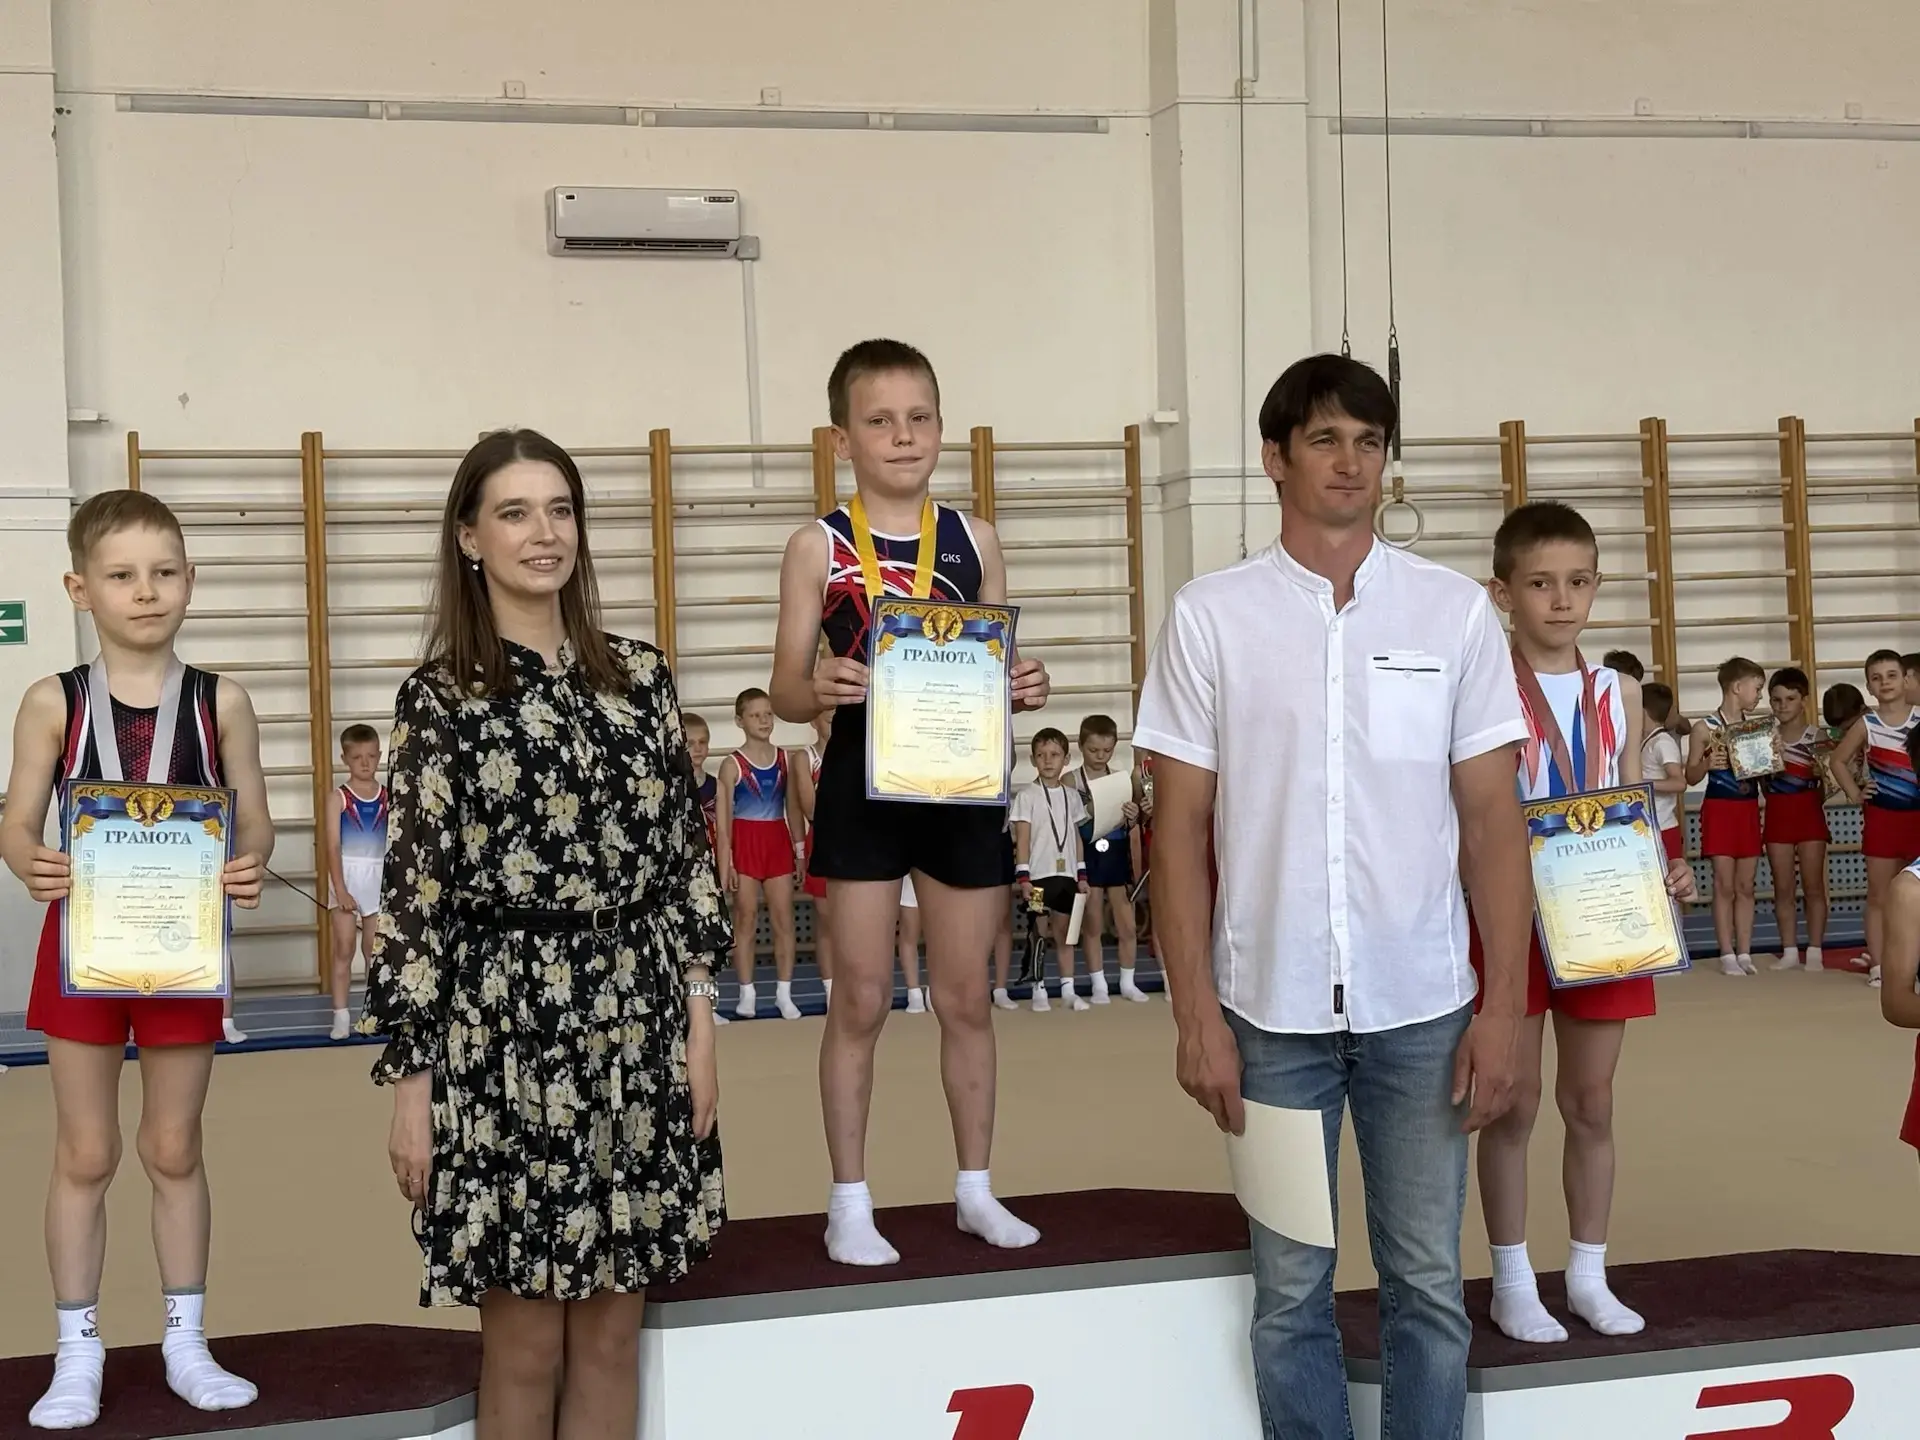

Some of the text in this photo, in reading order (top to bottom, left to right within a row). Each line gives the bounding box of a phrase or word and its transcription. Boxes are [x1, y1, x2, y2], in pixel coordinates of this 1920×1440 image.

[941, 553, 961, 563] GKS
[902, 648, 977, 664] ГРАМОТА
[104, 830, 193, 845] ГРАМОТА
[1556, 836, 1628, 858] ГРАМОТА
